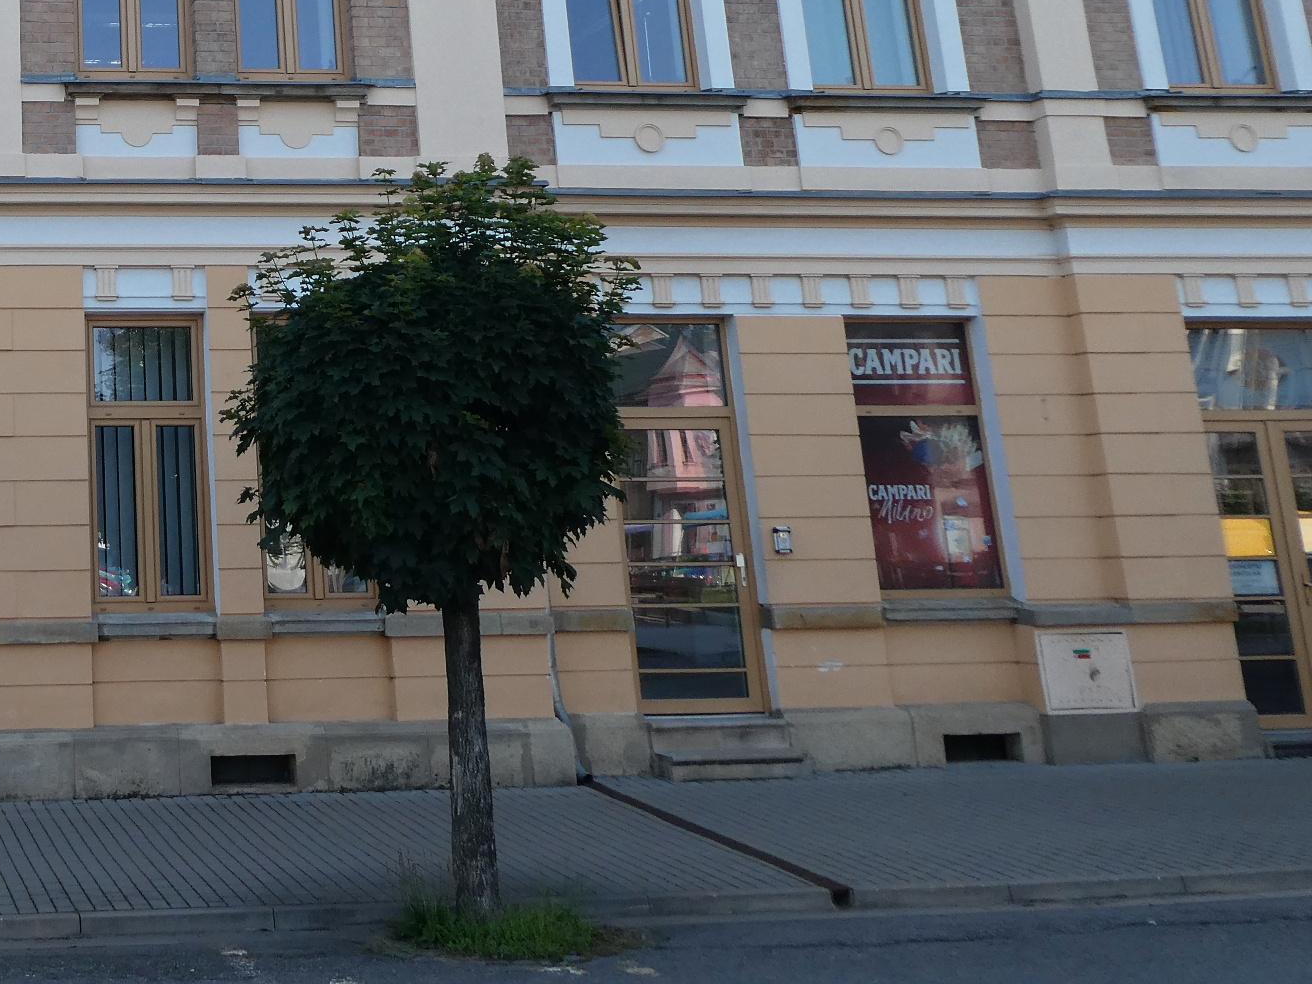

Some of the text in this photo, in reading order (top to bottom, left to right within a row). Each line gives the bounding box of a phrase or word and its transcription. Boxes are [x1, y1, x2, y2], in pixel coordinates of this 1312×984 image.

[848, 347, 962, 376] CAMPARI
[868, 484, 932, 500] CAMPARI
[878, 497, 934, 524] Milano
